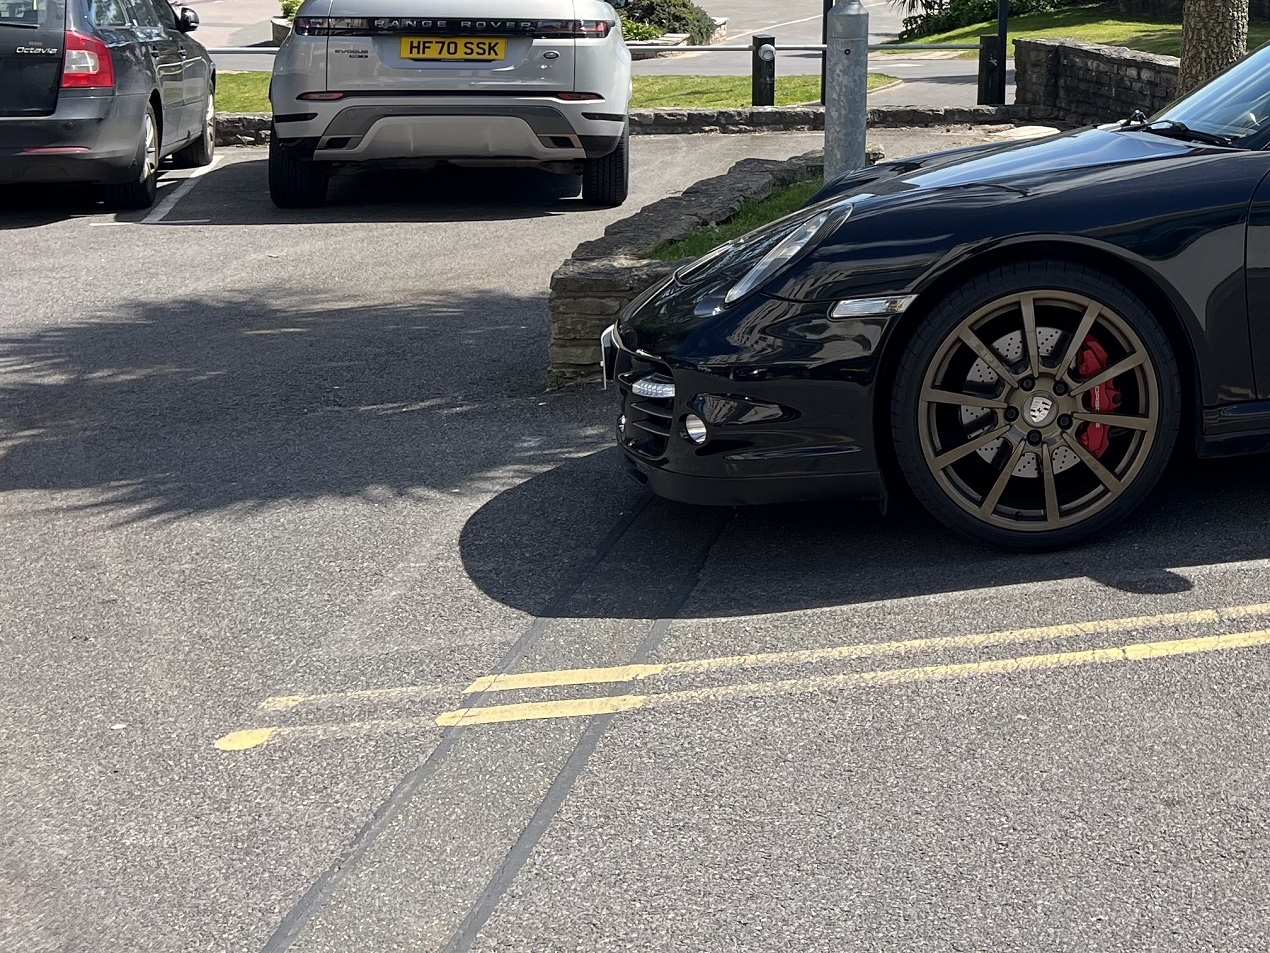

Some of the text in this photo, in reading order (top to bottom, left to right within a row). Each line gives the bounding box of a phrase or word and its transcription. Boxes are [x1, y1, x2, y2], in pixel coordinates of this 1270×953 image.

[374, 19, 531, 28] RANGE ROVER
[16, 46, 58, 54] Octavia
[409, 40, 499, 56] HF70 SSK
